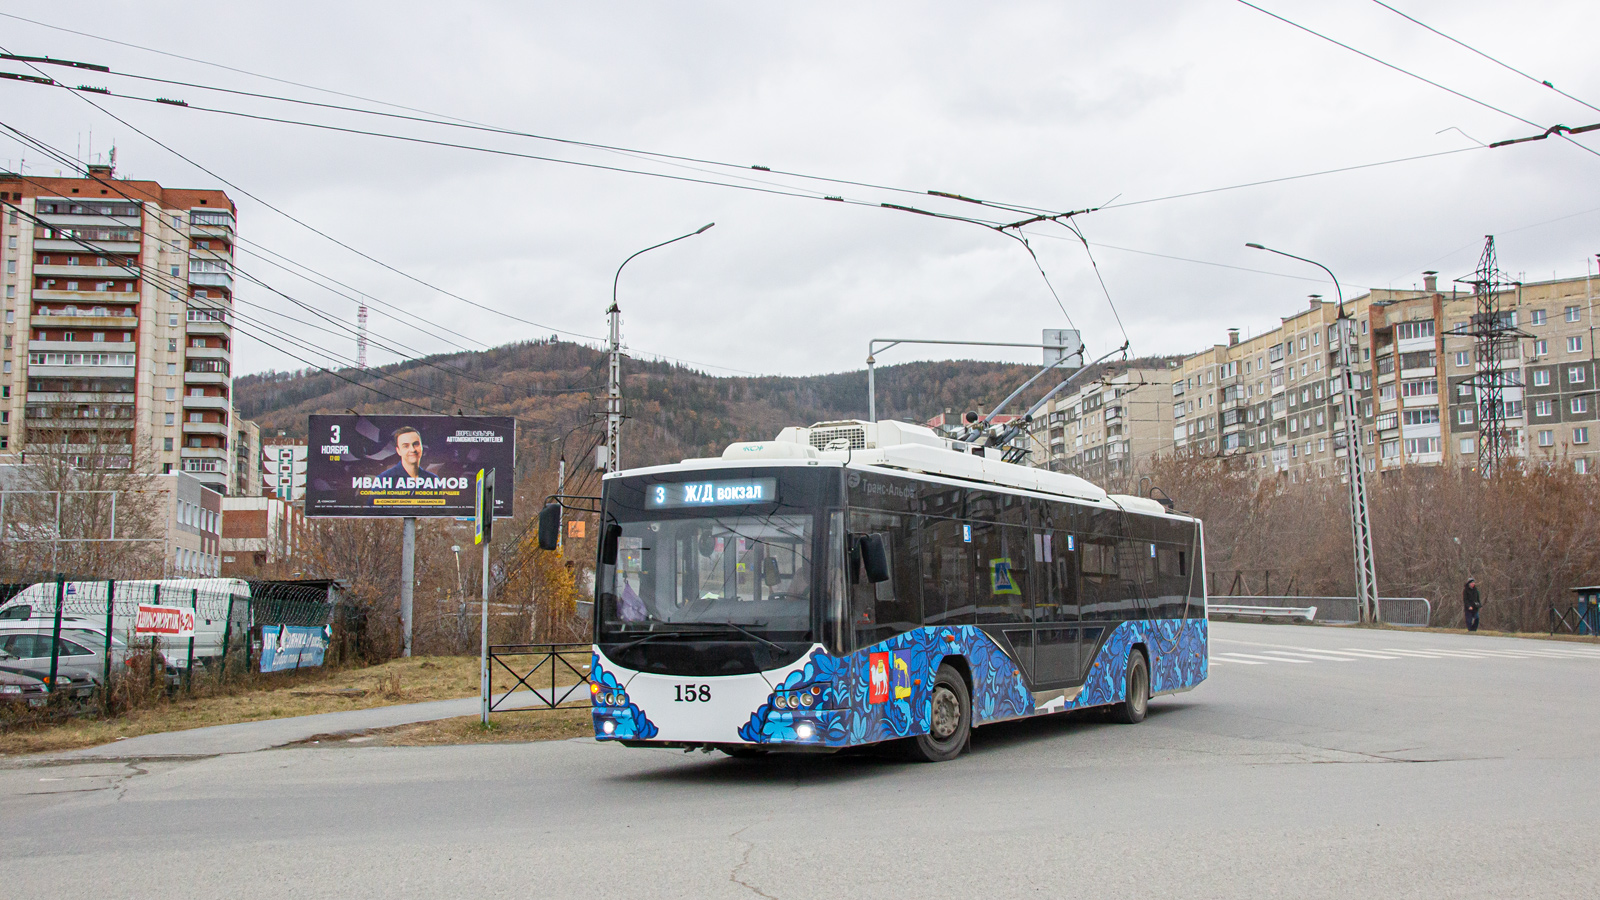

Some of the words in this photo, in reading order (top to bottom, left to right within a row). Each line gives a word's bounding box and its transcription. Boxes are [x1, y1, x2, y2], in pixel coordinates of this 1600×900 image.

[330, 425, 340, 443] 3
[321, 446, 348, 454] НОЯБРЯ
[352, 477, 392, 488] ИВАН
[396, 477, 468, 489] АБРАМОВ
[862, 478, 917, 498] Транс-Альфа
[656, 486, 665, 504] 3
[684, 484, 714, 502] Ж/Д
[717, 486, 762, 500] вокзал
[674, 684, 712, 702] 158
